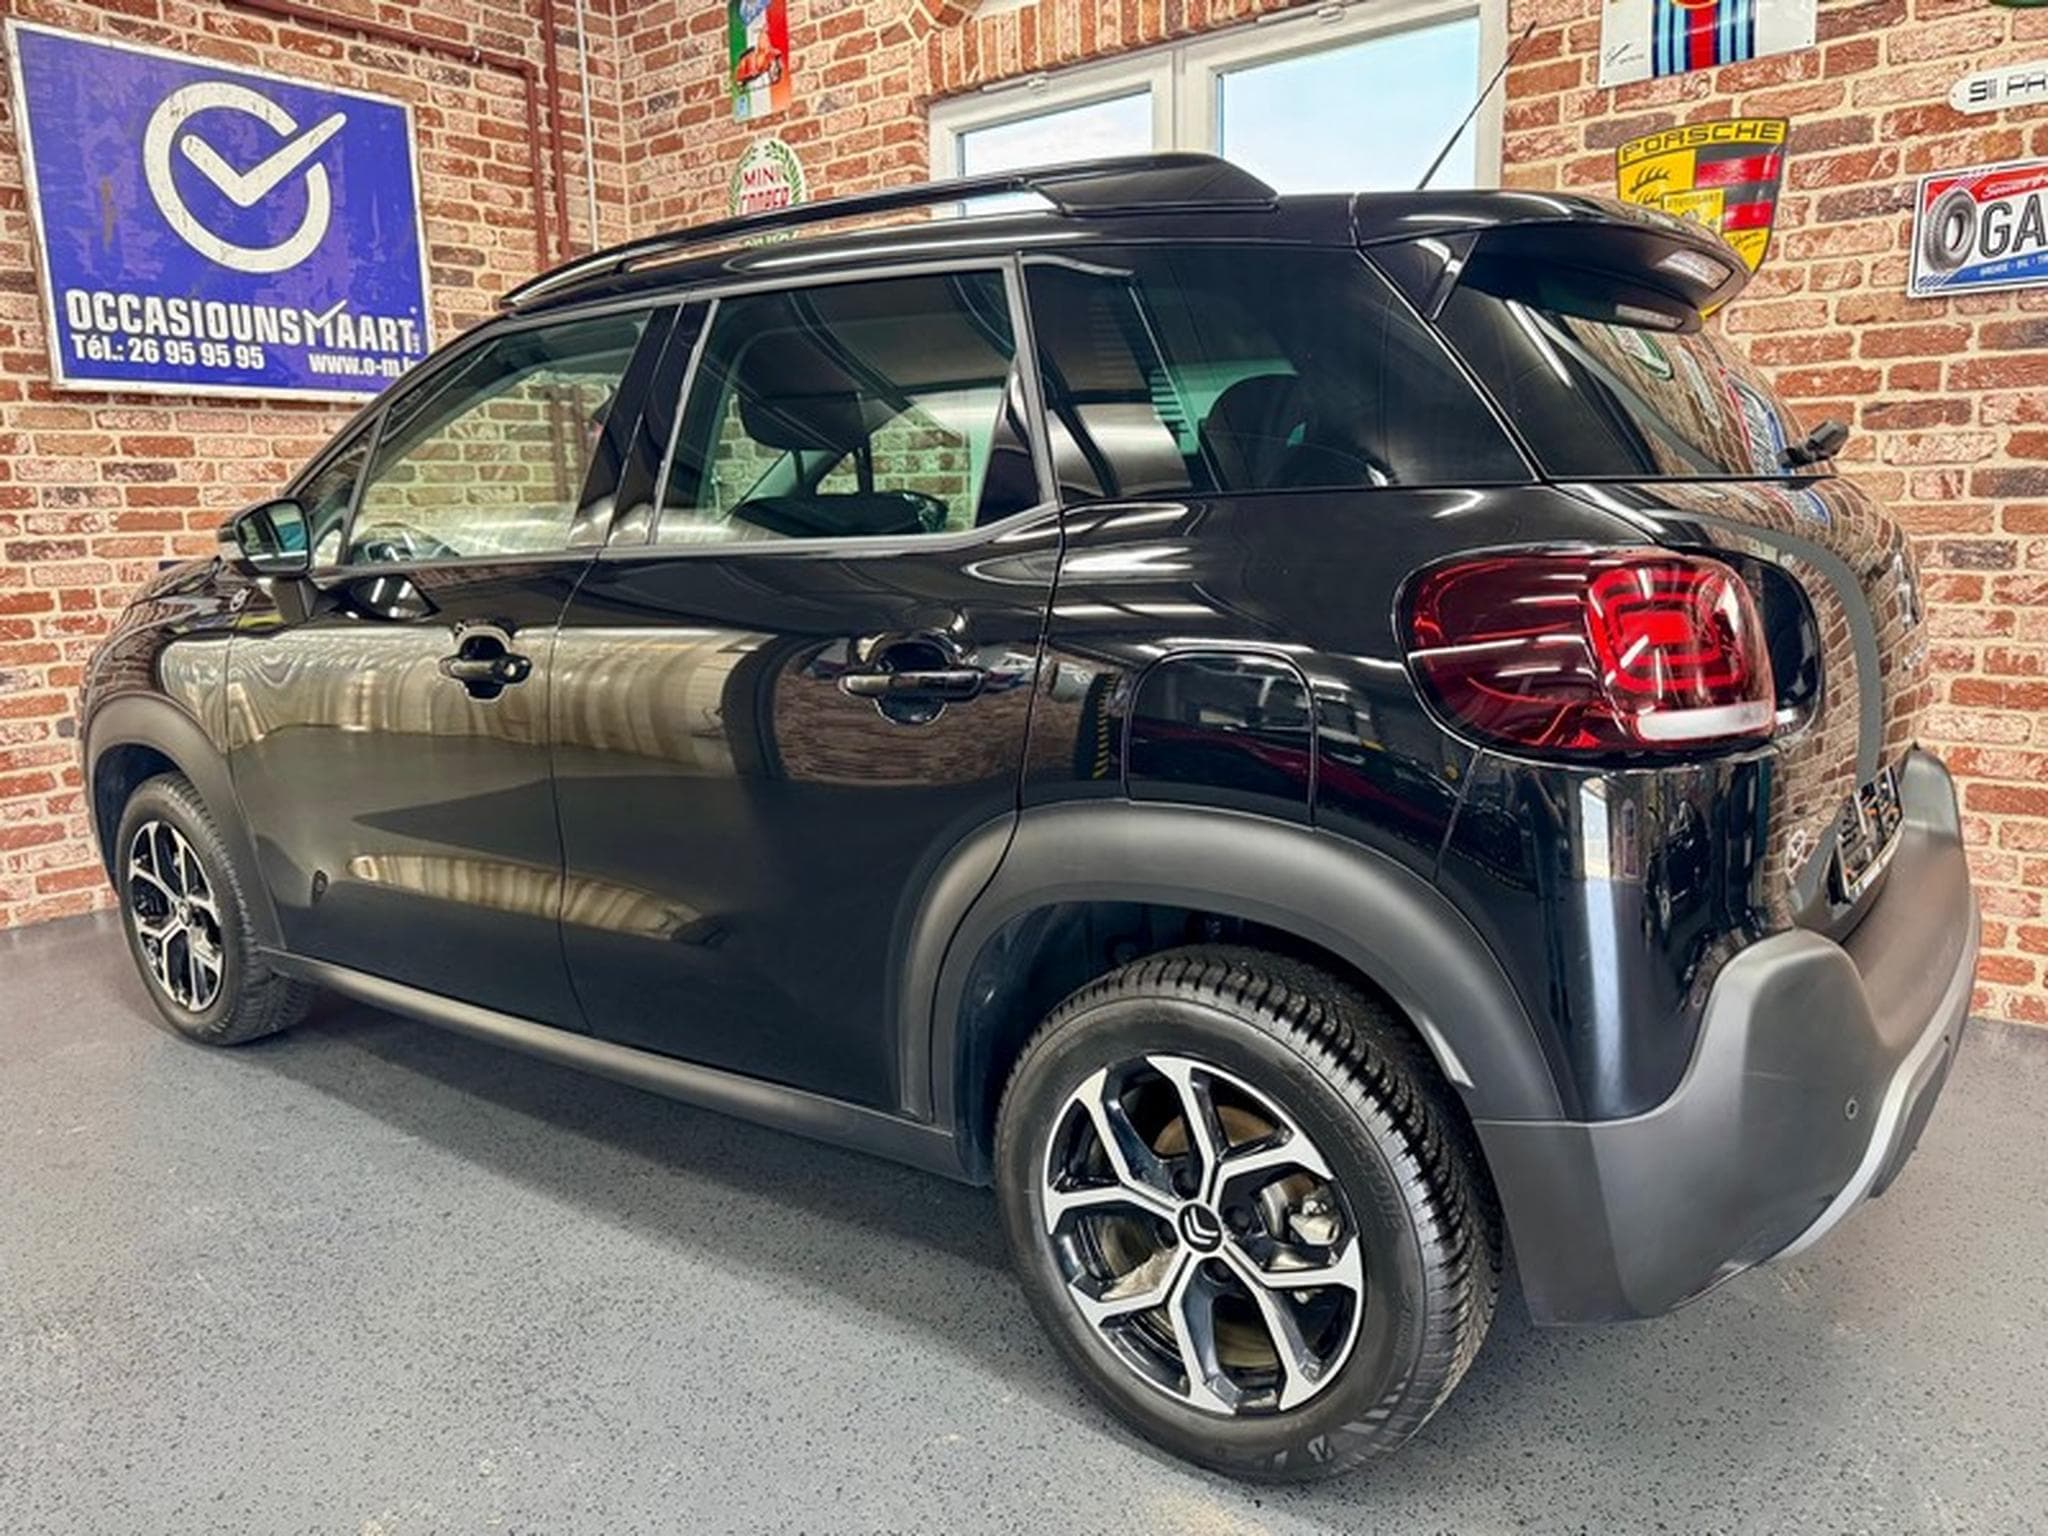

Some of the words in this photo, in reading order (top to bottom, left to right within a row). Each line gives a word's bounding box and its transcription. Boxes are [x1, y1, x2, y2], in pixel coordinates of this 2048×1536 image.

[2006, 71, 2048, 97] PA
[1621, 123, 1781, 162] PORSCHE
[65, 289, 415, 354] OCCASIOUNSMAART
[70, 334, 125, 362] Tél.:
[127, 337, 160, 365] 26
[163, 340, 197, 366] 95
[200, 342, 232, 368] 95
[234, 344, 266, 370] 95
